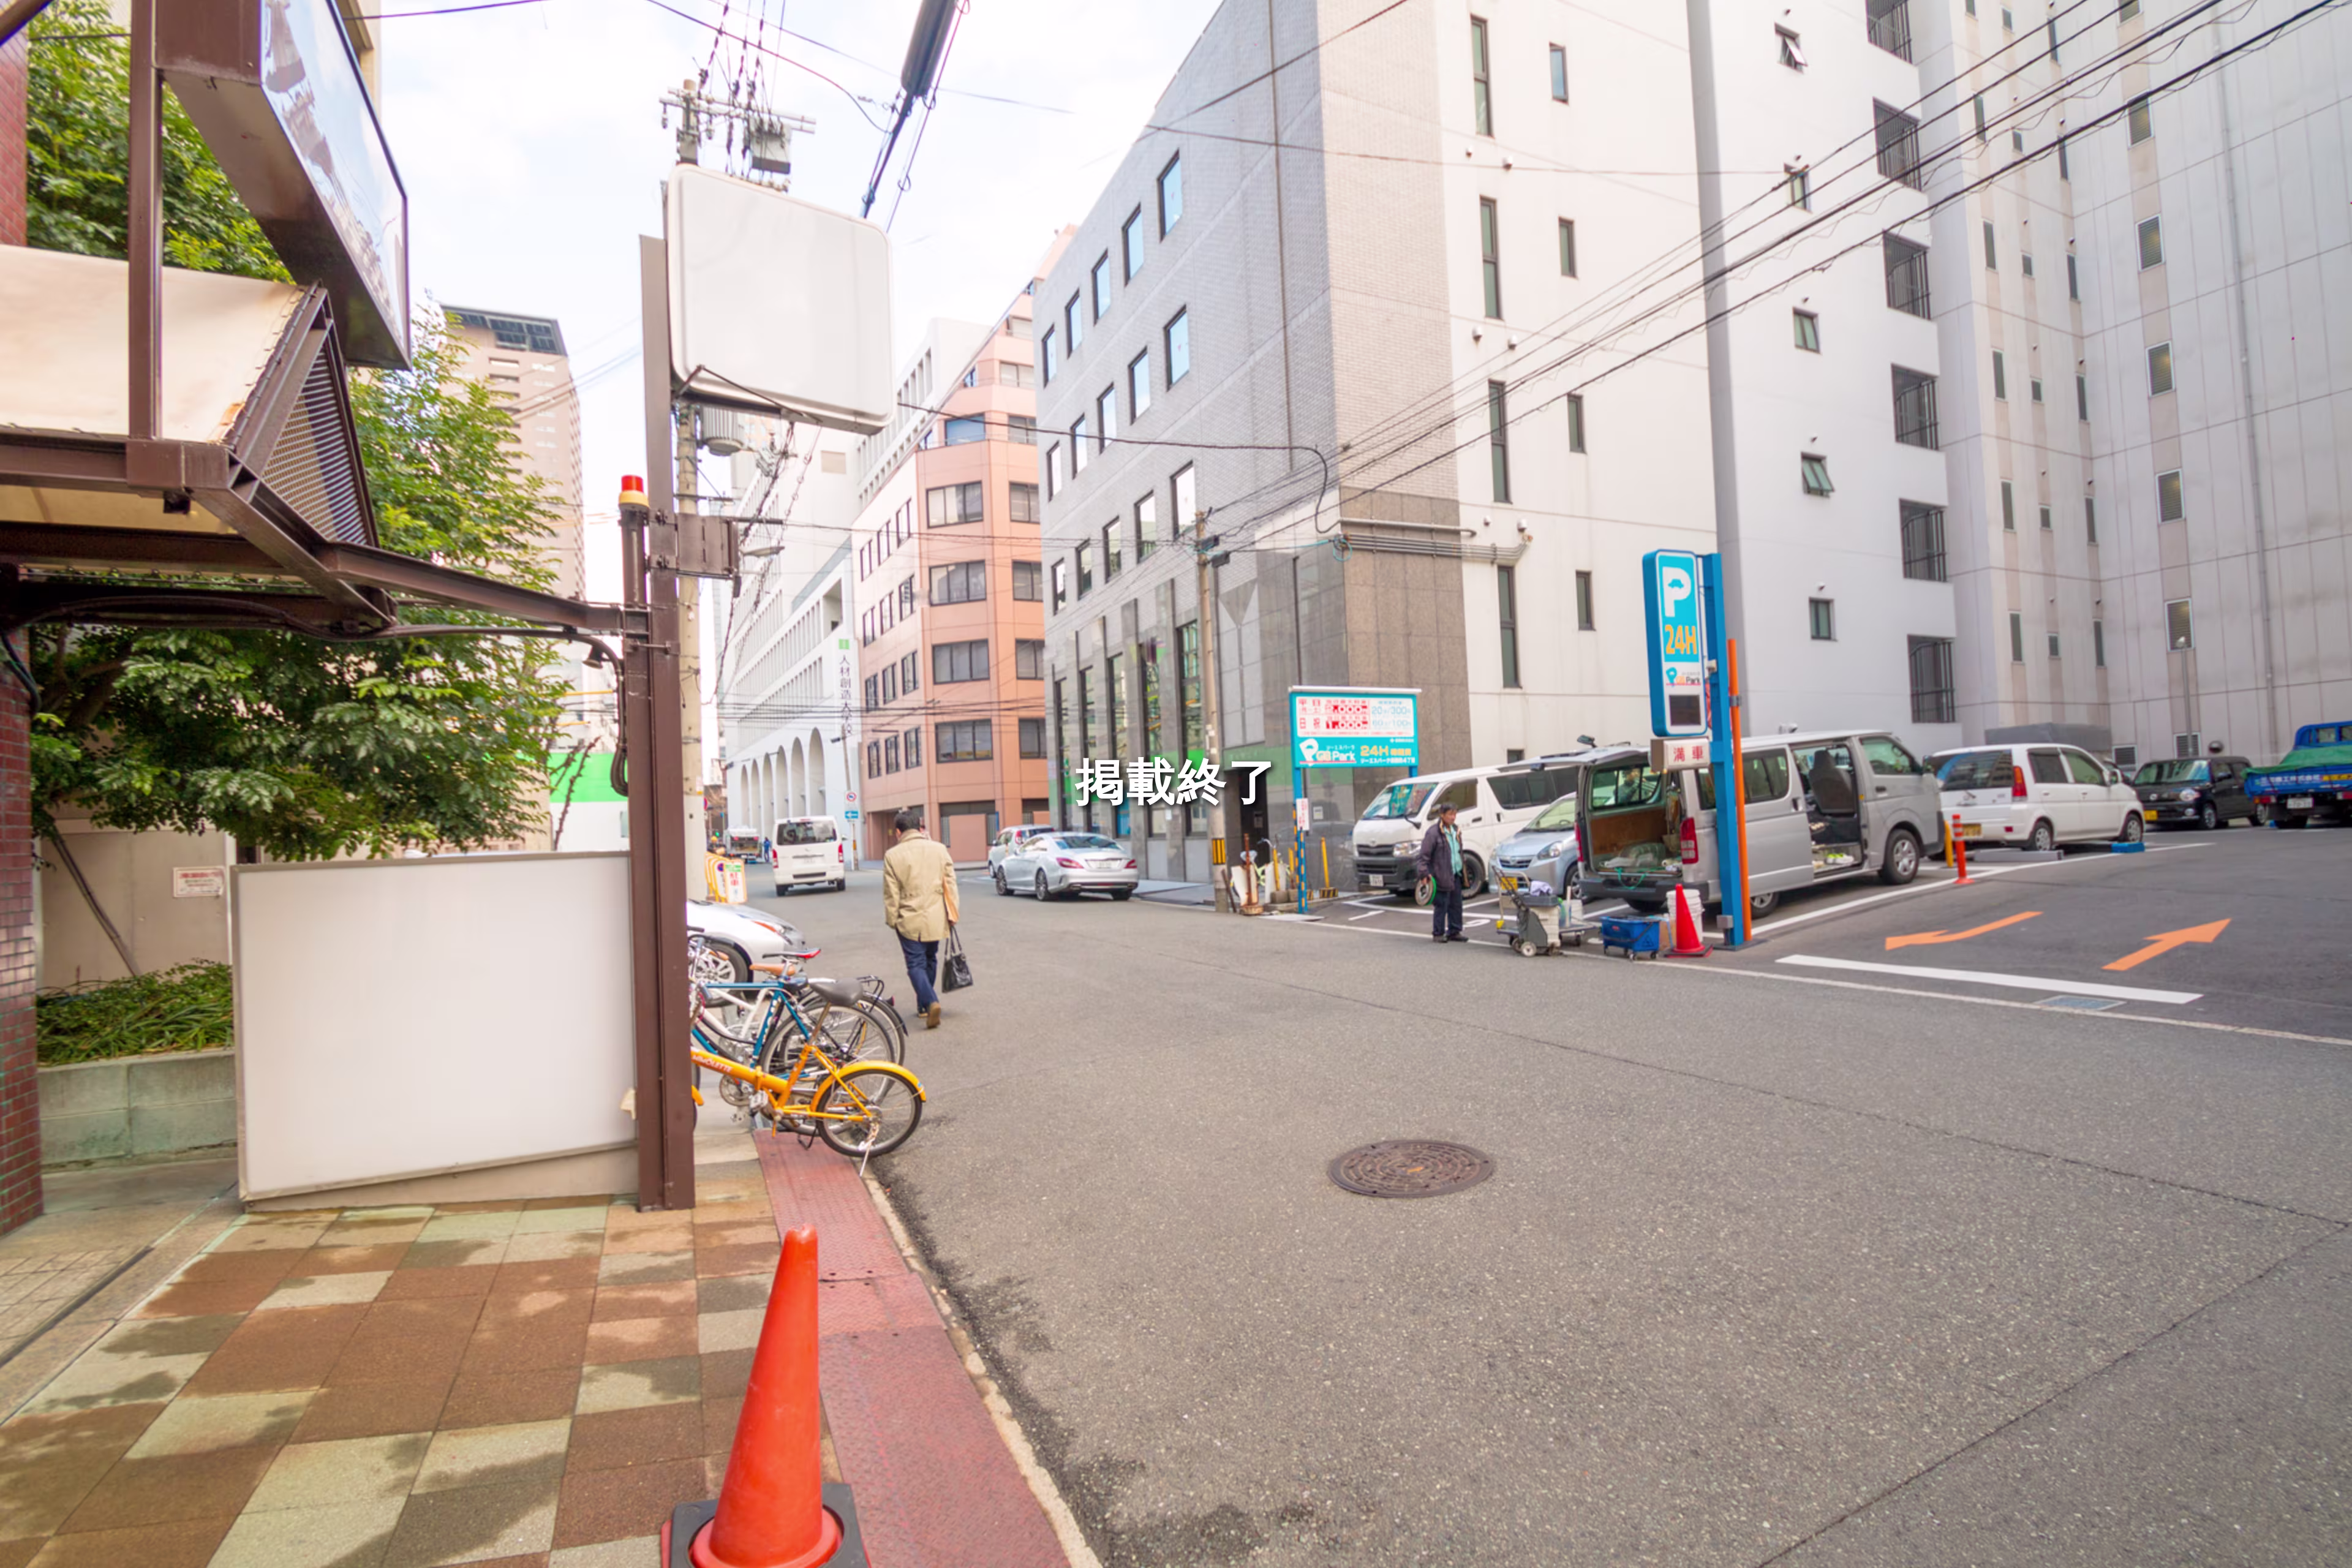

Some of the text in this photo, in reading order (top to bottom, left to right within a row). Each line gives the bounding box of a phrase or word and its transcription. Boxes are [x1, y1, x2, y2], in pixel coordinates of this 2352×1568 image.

[1662, 566, 1692, 617] P
[1664, 624, 1698, 655] 24H
[1332, 750, 1355, 761] Park
[1360, 745, 1389, 756] 24H
[1673, 745, 1704, 762] 満車
